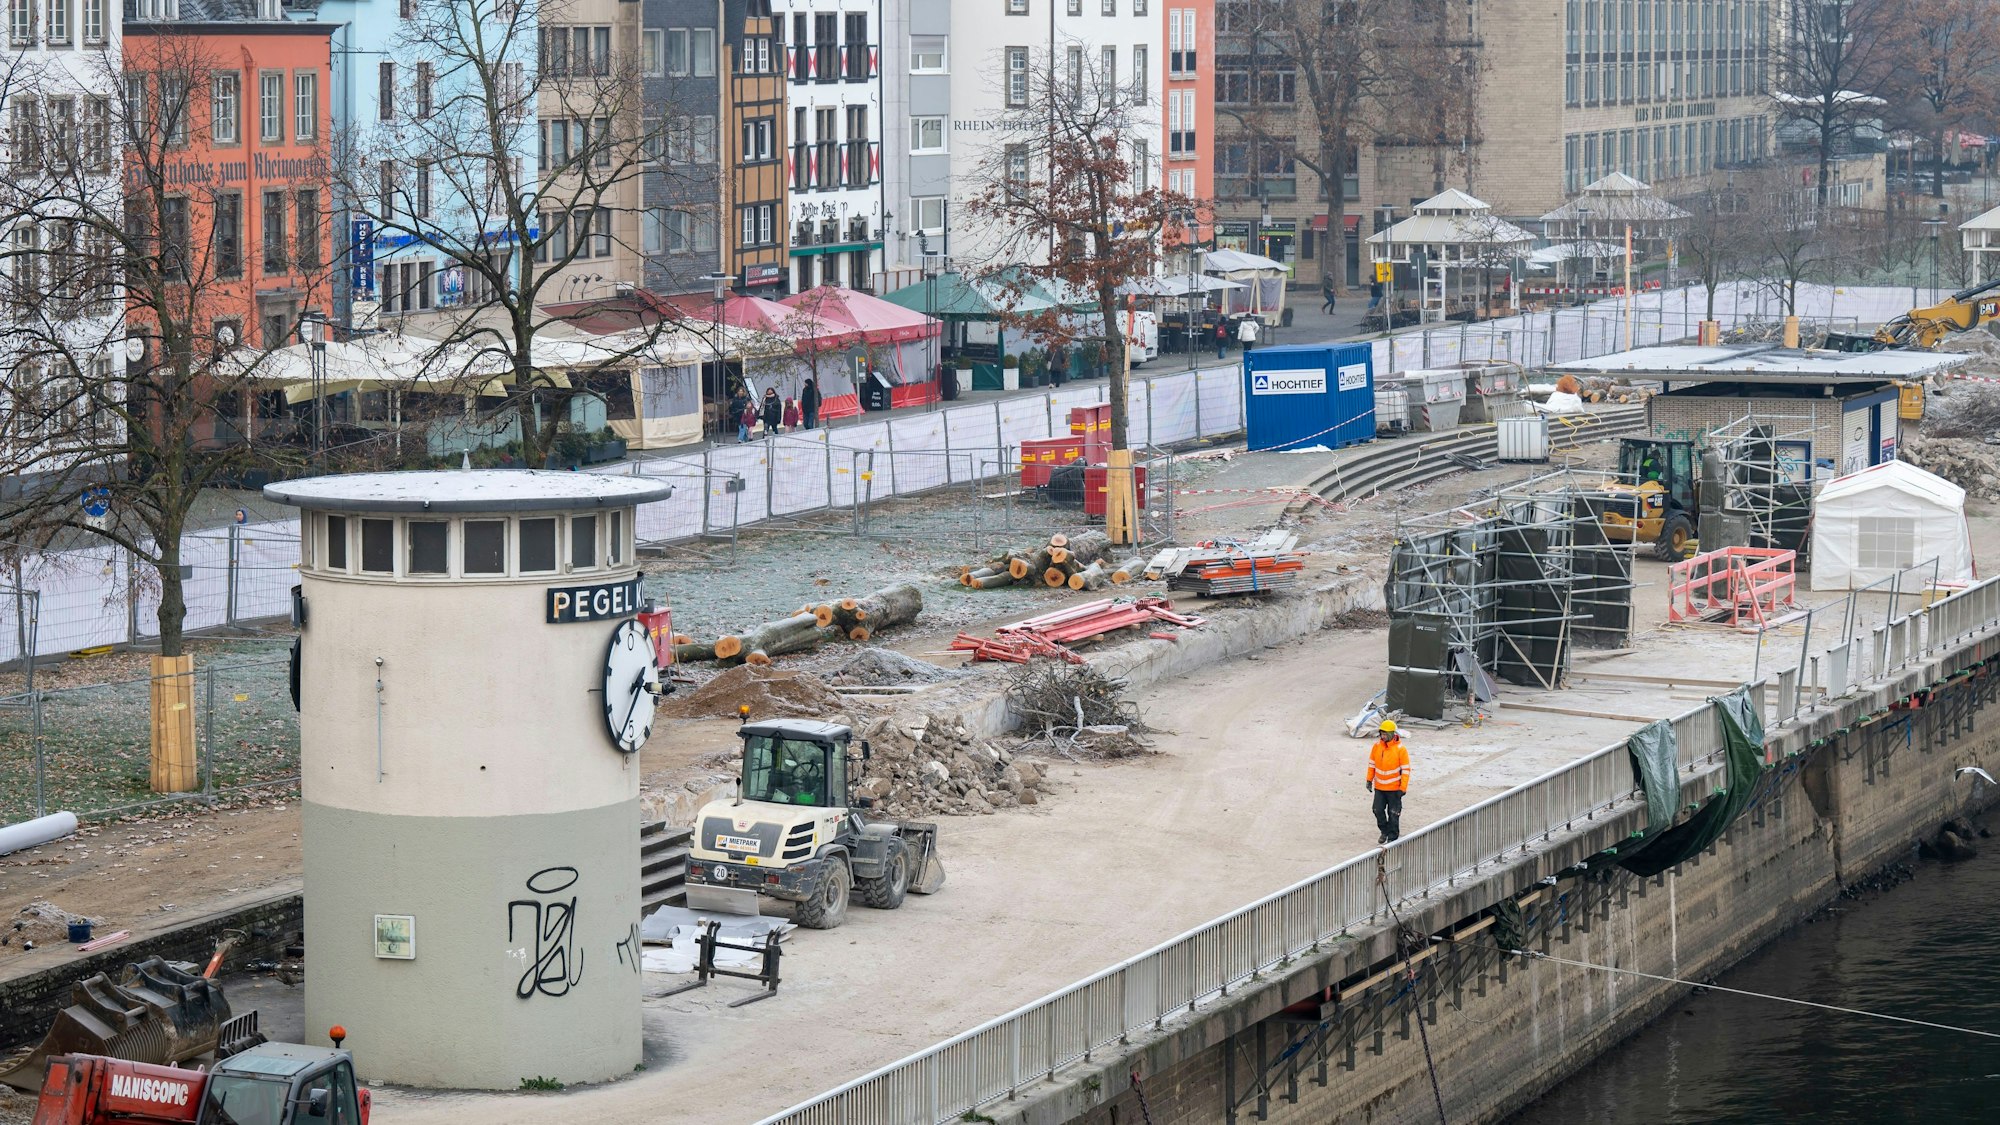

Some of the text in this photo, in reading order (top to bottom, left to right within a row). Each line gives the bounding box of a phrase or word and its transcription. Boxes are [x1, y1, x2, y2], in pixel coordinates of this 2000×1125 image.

[219, 159, 247, 188] zum
[253, 152, 327, 185] Rheingarten
[1980, 303, 1995, 316] CAT
[1271, 379, 1323, 389] HOCHTIEF
[1346, 374, 1366, 385] HOCHTIEF
[553, 586, 632, 618] PEGEL
[628, 720, 634, 738] 5
[729, 837, 758, 848] MIETPARK
[716, 868, 725, 878] 20
[111, 1074, 189, 1106] MANISCOPIC
